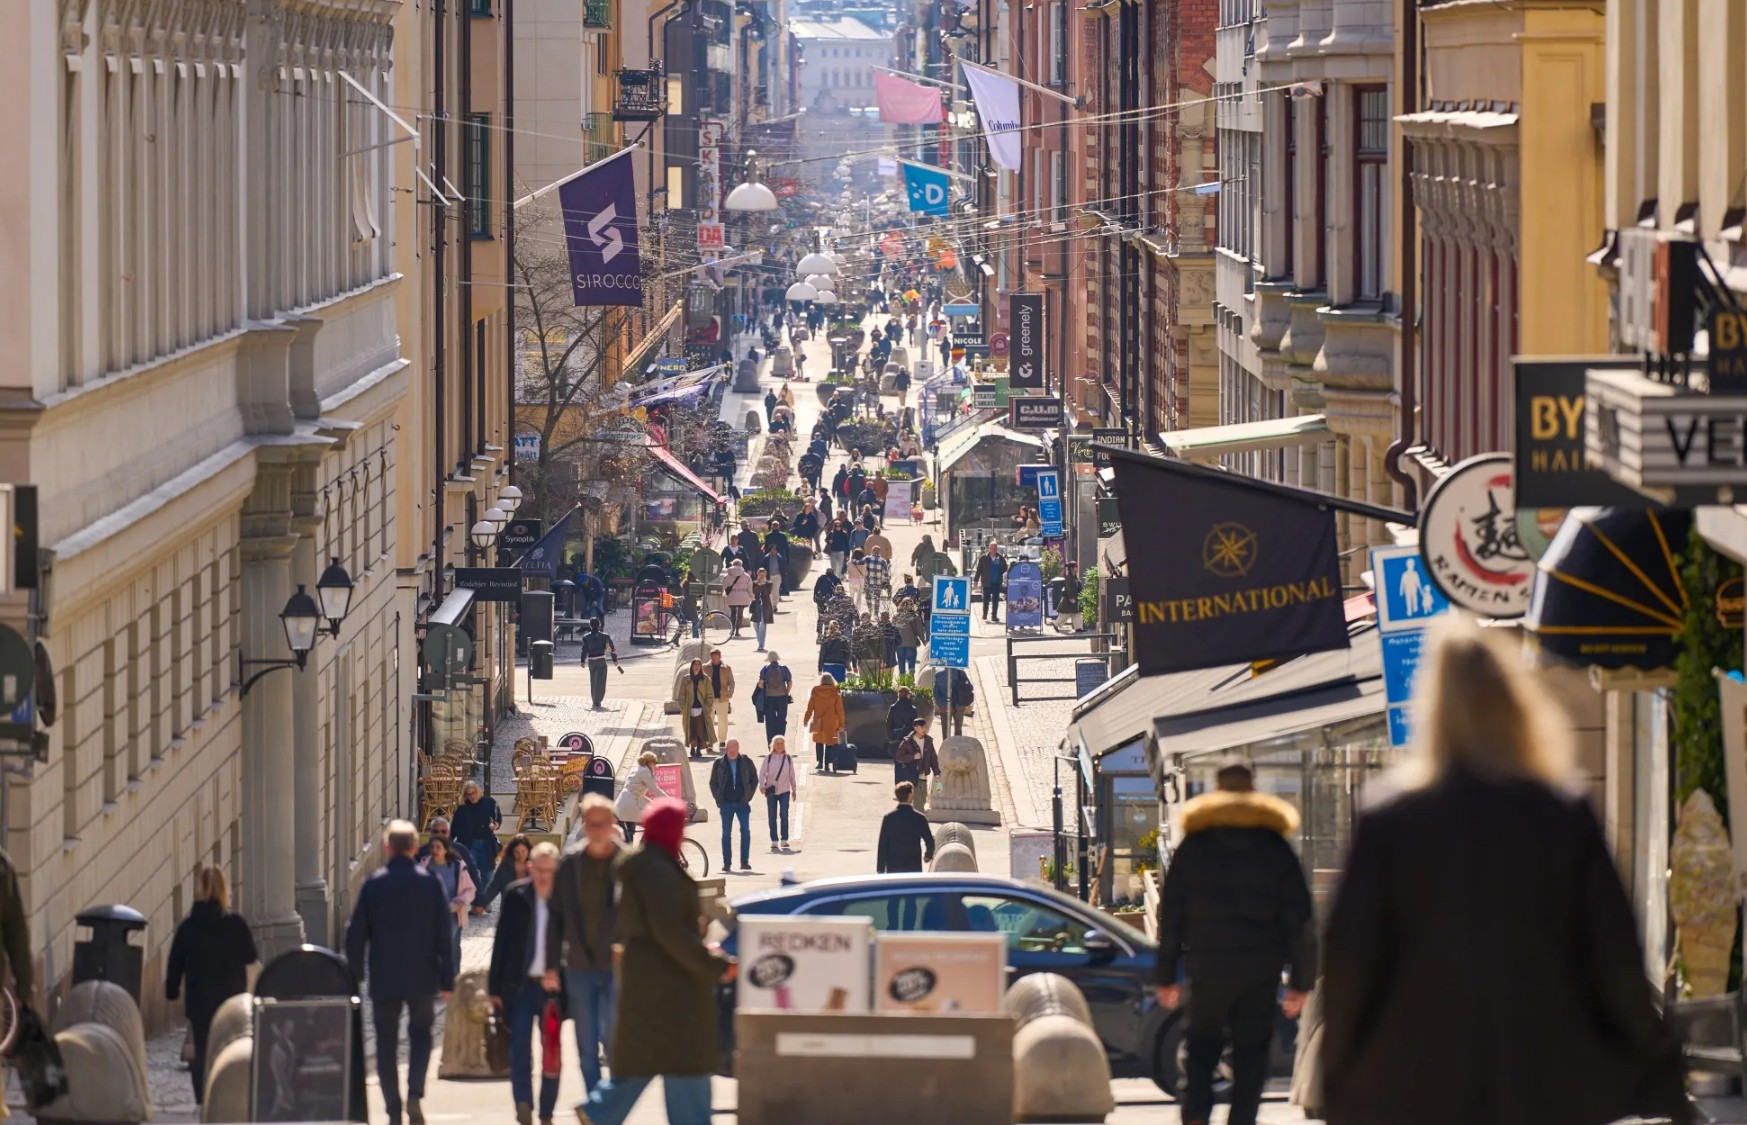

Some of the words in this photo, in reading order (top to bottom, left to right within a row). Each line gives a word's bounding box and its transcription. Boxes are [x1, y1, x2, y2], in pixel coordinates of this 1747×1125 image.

[576, 273, 640, 290] SIROCCO
[1018, 304, 1033, 356] greenely
[953, 337, 982, 345] NICOLE
[1097, 435, 1125, 444] INDIAN
[1666, 417, 1747, 468] VE
[505, 535, 535, 544] Synoptik
[489, 580, 517, 588] Revisited
[1138, 576, 1336, 624] INTERNATIONAL
[757, 930, 852, 952] REDKEN
